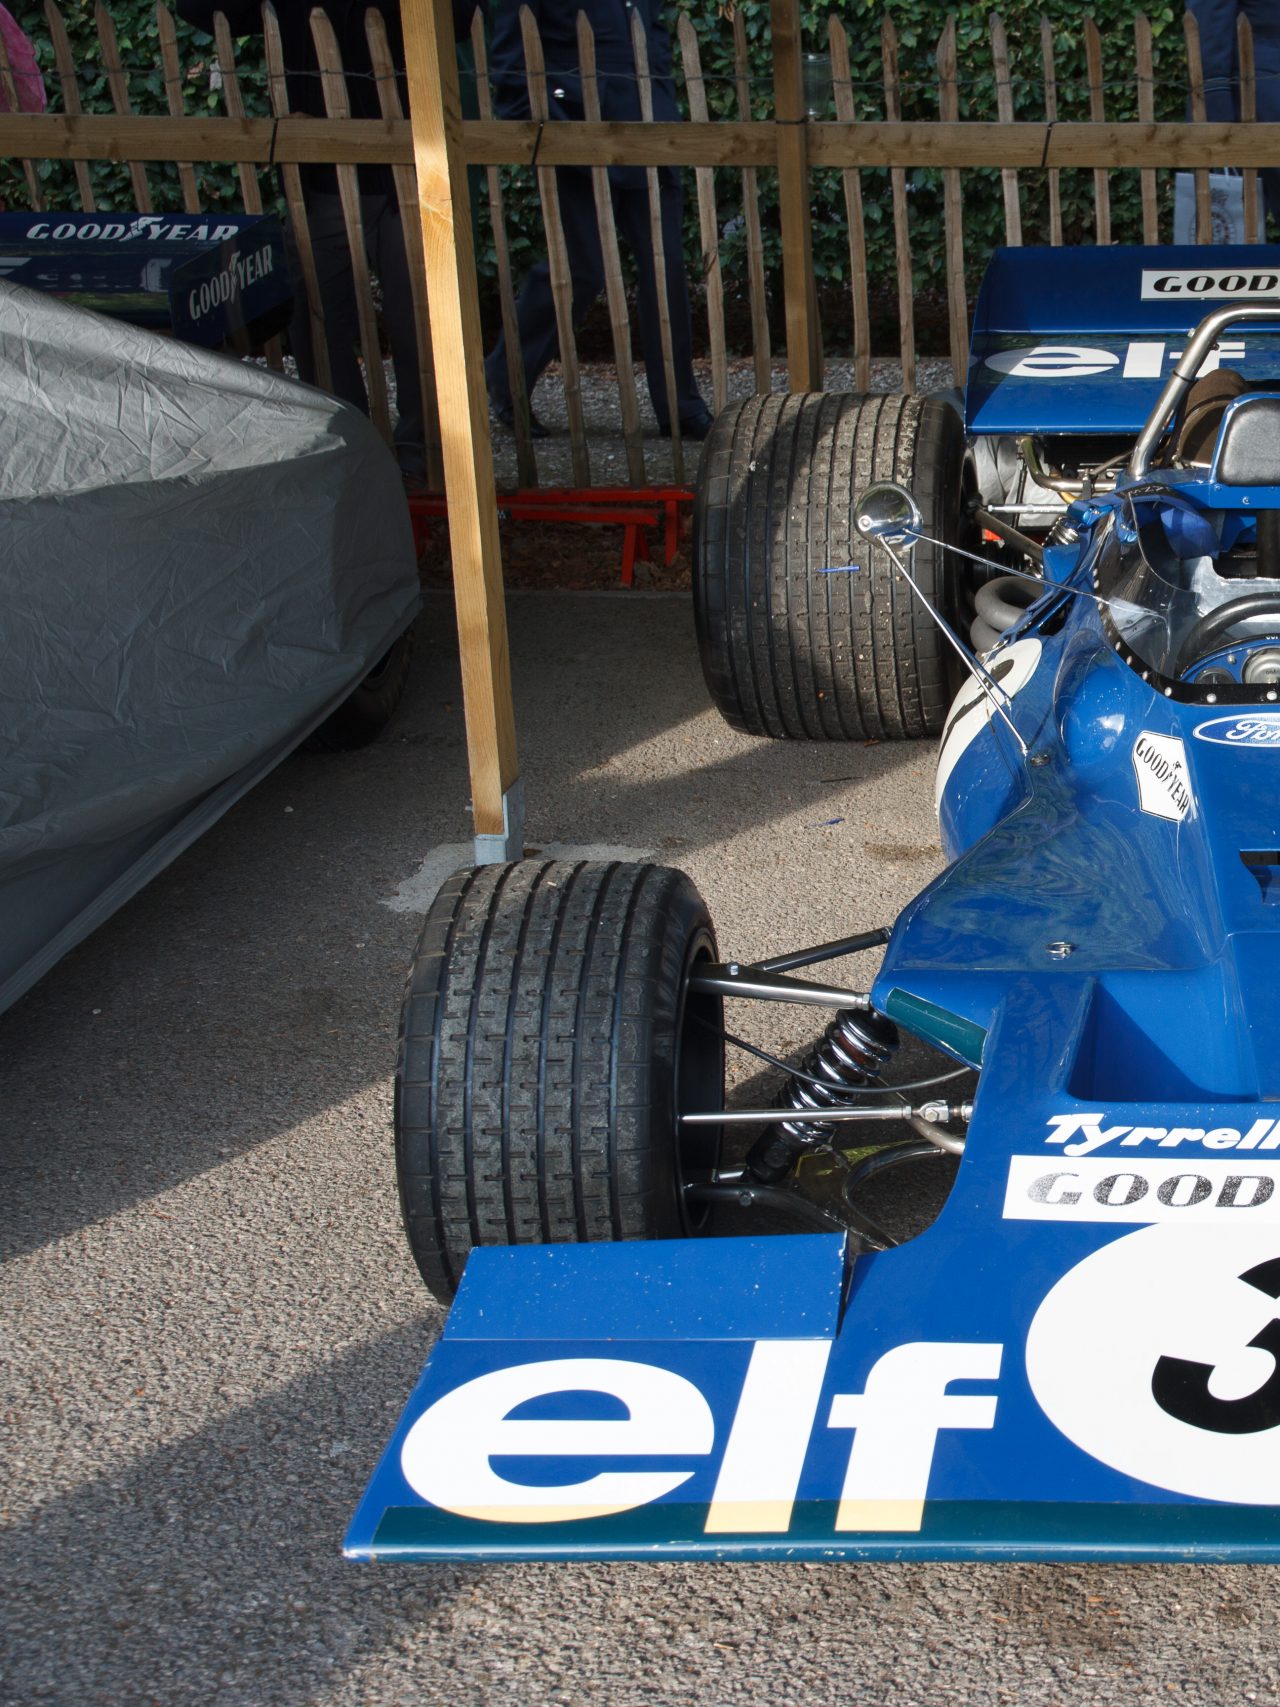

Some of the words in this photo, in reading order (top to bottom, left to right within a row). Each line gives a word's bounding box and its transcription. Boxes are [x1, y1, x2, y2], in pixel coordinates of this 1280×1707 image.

[26, 217, 239, 242] GOODYEAR
[189, 244, 273, 321] GOODYEAR
[1135, 737, 1190, 814] GOODYEAR
[400, 1340, 1003, 1533] elf
